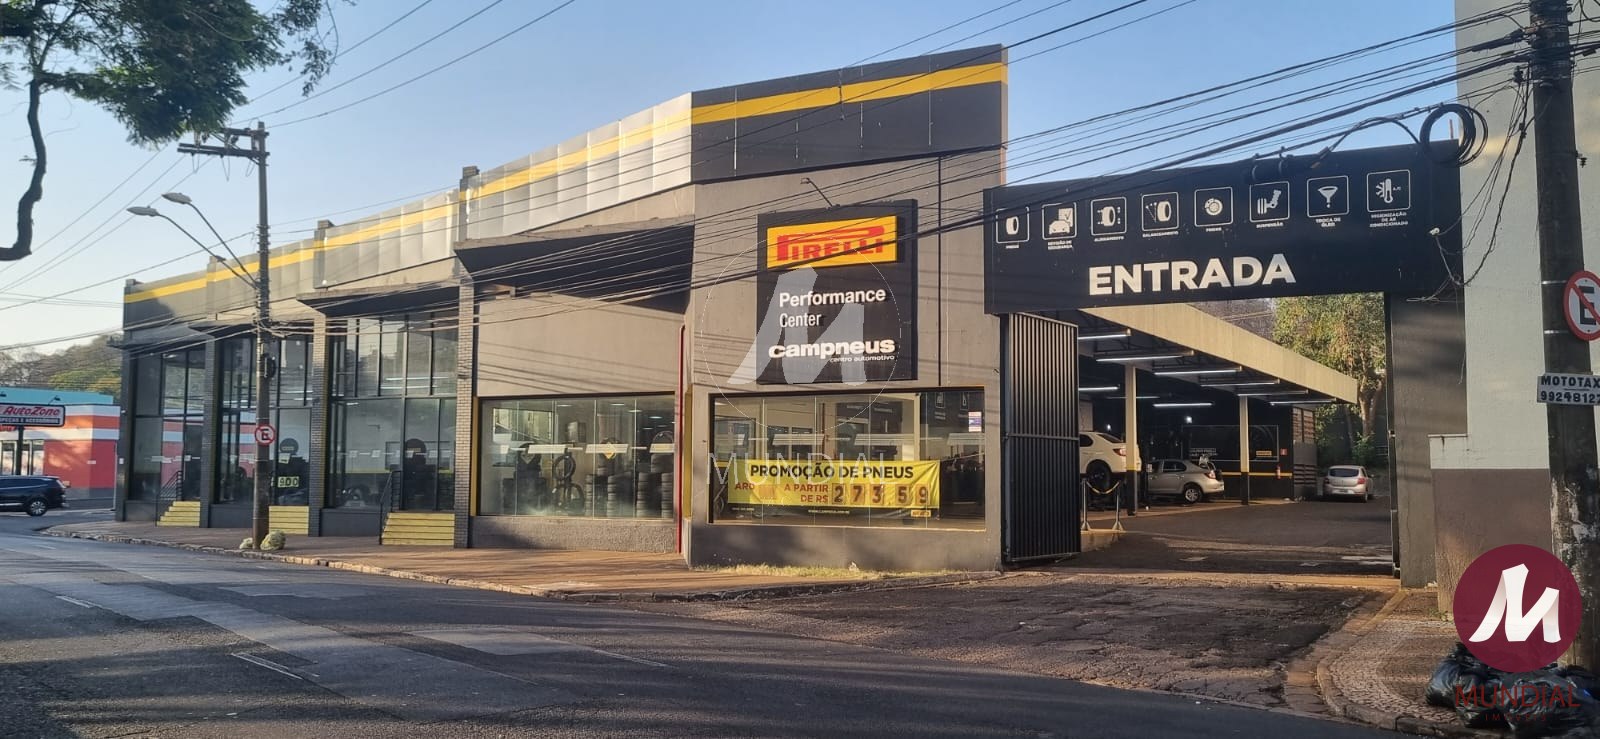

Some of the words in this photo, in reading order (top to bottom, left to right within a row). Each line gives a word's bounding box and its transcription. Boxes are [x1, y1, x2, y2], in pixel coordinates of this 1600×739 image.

[776, 225, 885, 262] PIRELLI
[1088, 253, 1297, 296] ENTRADA
[779, 288, 886, 307] Performance
[779, 312, 822, 328] Center
[768, 339, 895, 360] campneus
[853, 354, 895, 362] automotivo
[750, 462, 835, 480] PROMOÇÃO
[838, 465, 859, 478] DE
[862, 466, 914, 479] PNEUS
[735, 482, 755, 490] ARO
[783, 483, 792, 492] A
[793, 483, 829, 493] PARTIR
[800, 494, 814, 503] DE
[815, 494, 829, 504] R$
